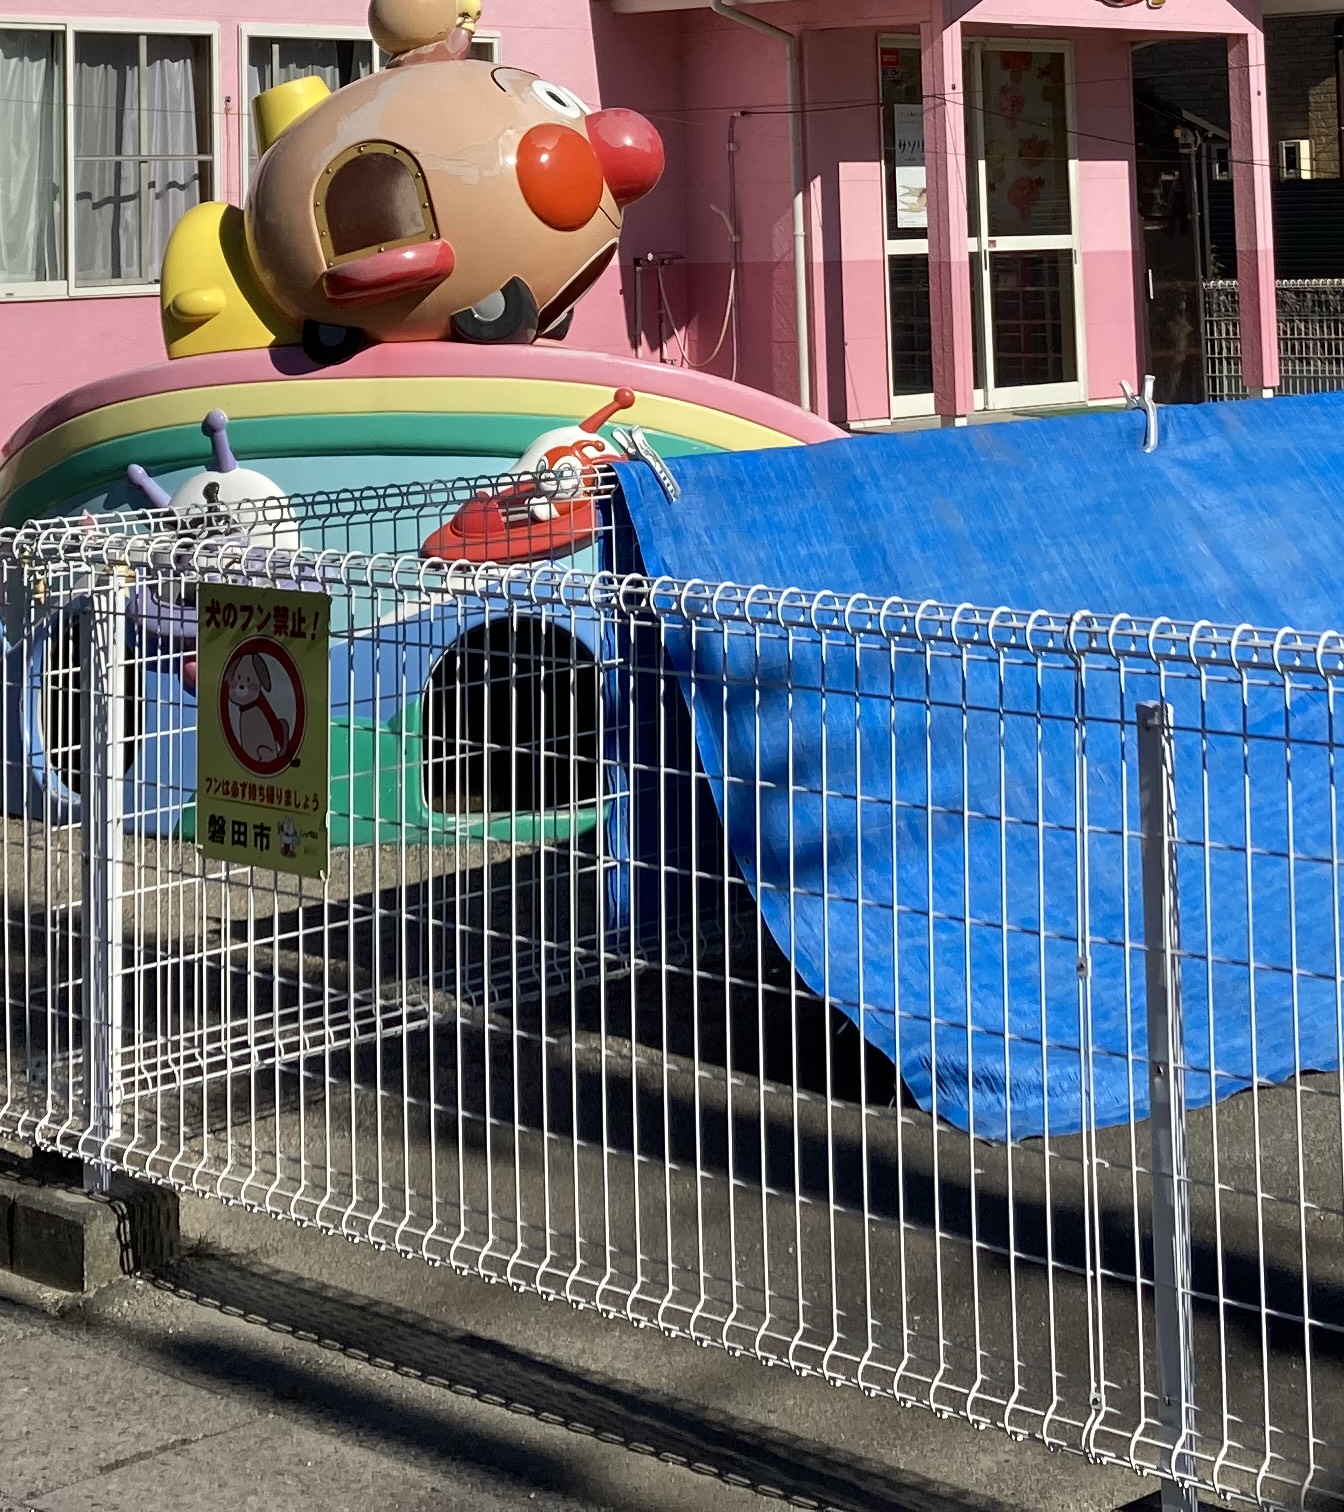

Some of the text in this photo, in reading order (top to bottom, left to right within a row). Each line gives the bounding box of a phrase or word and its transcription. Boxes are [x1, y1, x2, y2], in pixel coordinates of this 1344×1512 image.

[205, 598, 320, 641] 犬のフン禁止！
[205, 776, 319, 812] フンは必ず持ち帰りましょう
[207, 813, 272, 852] 磐田市
